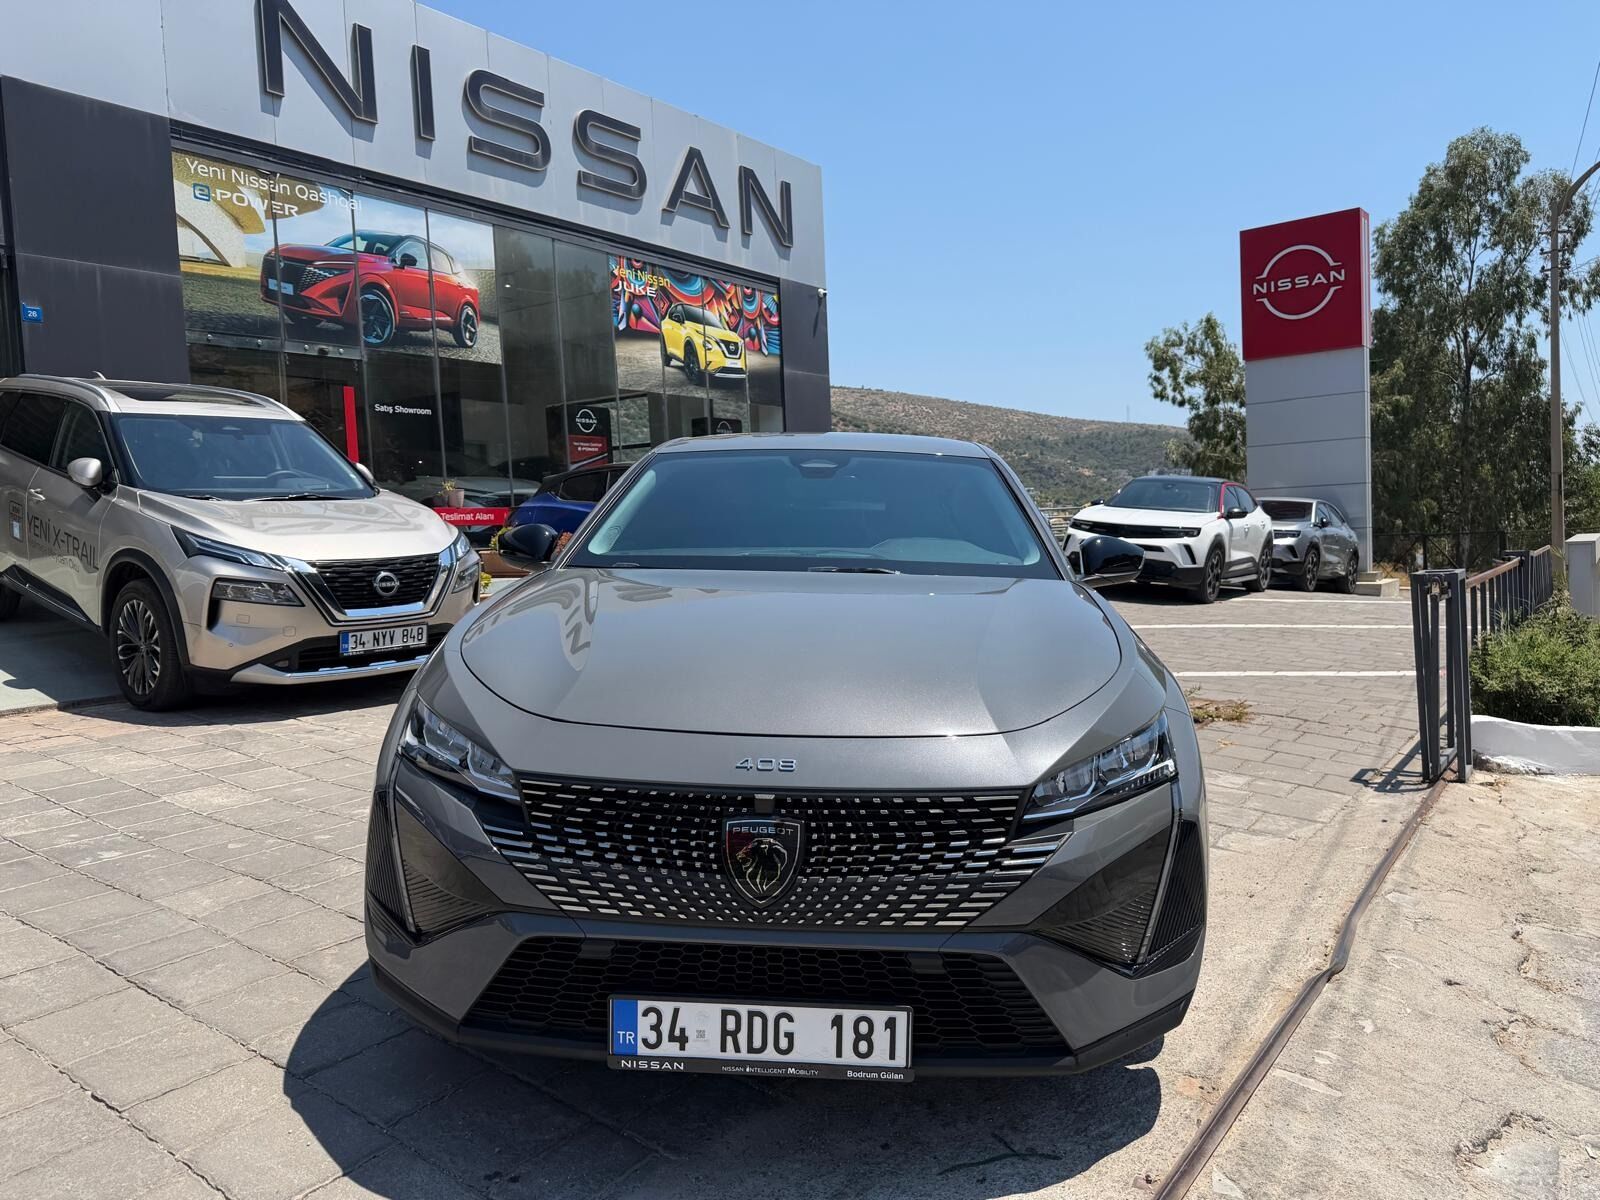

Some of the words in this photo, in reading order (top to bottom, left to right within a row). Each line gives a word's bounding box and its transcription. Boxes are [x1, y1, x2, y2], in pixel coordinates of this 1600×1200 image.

[255, 0, 793, 248] NISSAN
[185, 157, 226, 180] Yeni
[231, 168, 291, 196] Nissan
[295, 184, 362, 211] Qashqai
[637, 269, 671, 288] Nissan
[1253, 268, 1345, 295] NISSAN
[613, 280, 657, 297] JUKE
[374, 403, 394, 414] Satış
[394, 405, 432, 416] Showroom
[440, 512, 475, 521] Teslimat
[475, 512, 495, 521] Alanı
[52, 525, 100, 571] X-TRAIL
[373, 580, 400, 588] NISSAN
[350, 633, 366, 650] 34
[372, 630, 396, 647] NYV
[402, 627, 424, 644] 848
[735, 757, 797, 772] 408
[732, 825, 795, 836] PEUGEOT
[617, 1030, 635, 1045] TR
[641, 1006, 689, 1052] 34
[720, 1008, 795, 1056] RDG
[831, 1014, 897, 1061] 181
[621, 1059, 685, 1071] NISSAN
[847, 1070, 879, 1079] Bodrum
[880, 1071, 905, 1080] Gülan
